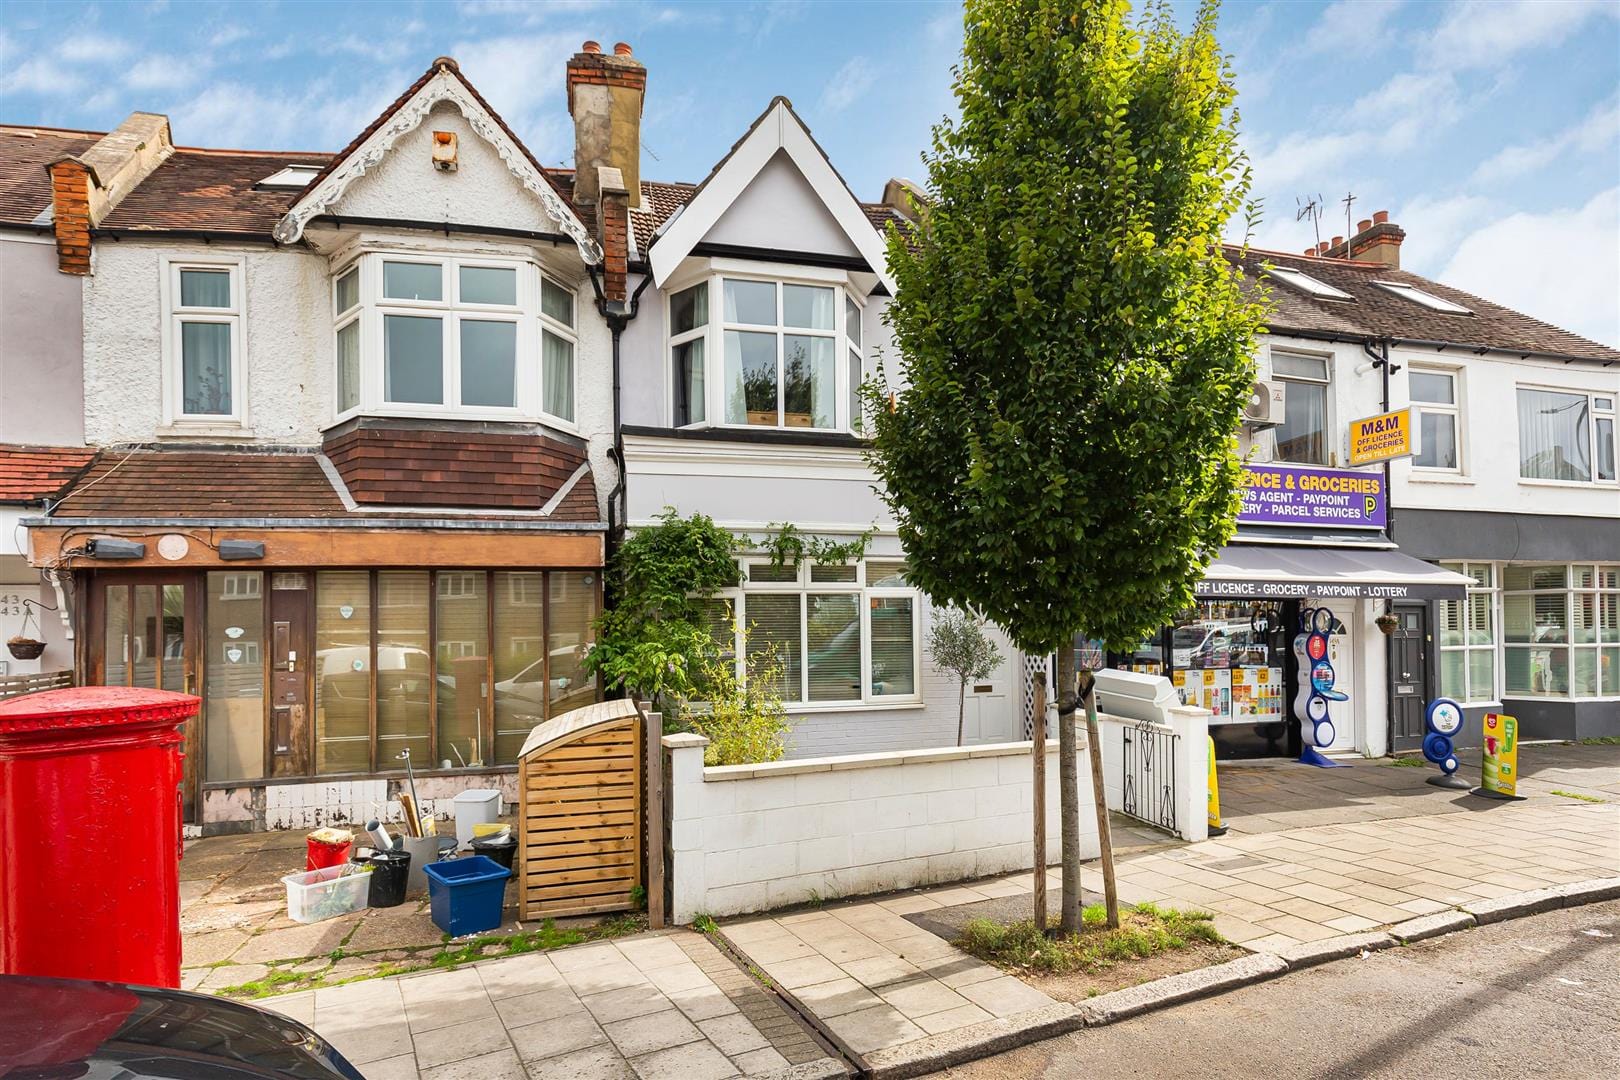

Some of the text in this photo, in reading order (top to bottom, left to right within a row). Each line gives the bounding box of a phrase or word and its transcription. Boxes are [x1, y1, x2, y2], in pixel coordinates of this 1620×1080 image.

[1361, 416, 1399, 436] M&M
[1357, 430, 1403, 446] OFF LICENCE
[1363, 438, 1404, 452] GROCERIES
[1355, 452, 1372, 461] OPEN
[1373, 449, 1387, 457] TILL
[1240, 472, 1381, 494] ENCE & GROCERIES
[1260, 491, 1294, 503] AGENT
[1303, 493, 1350, 506] PAYPOINT
[1271, 504, 1311, 517] PARCEL
[1313, 506, 1361, 519] SERVICES
[1212, 582, 1255, 594] LICENCE
[1263, 583, 1309, 595] GROCERY
[1316, 585, 1360, 597] PAYPOINT
[1367, 586, 1408, 597] LOTTERY
